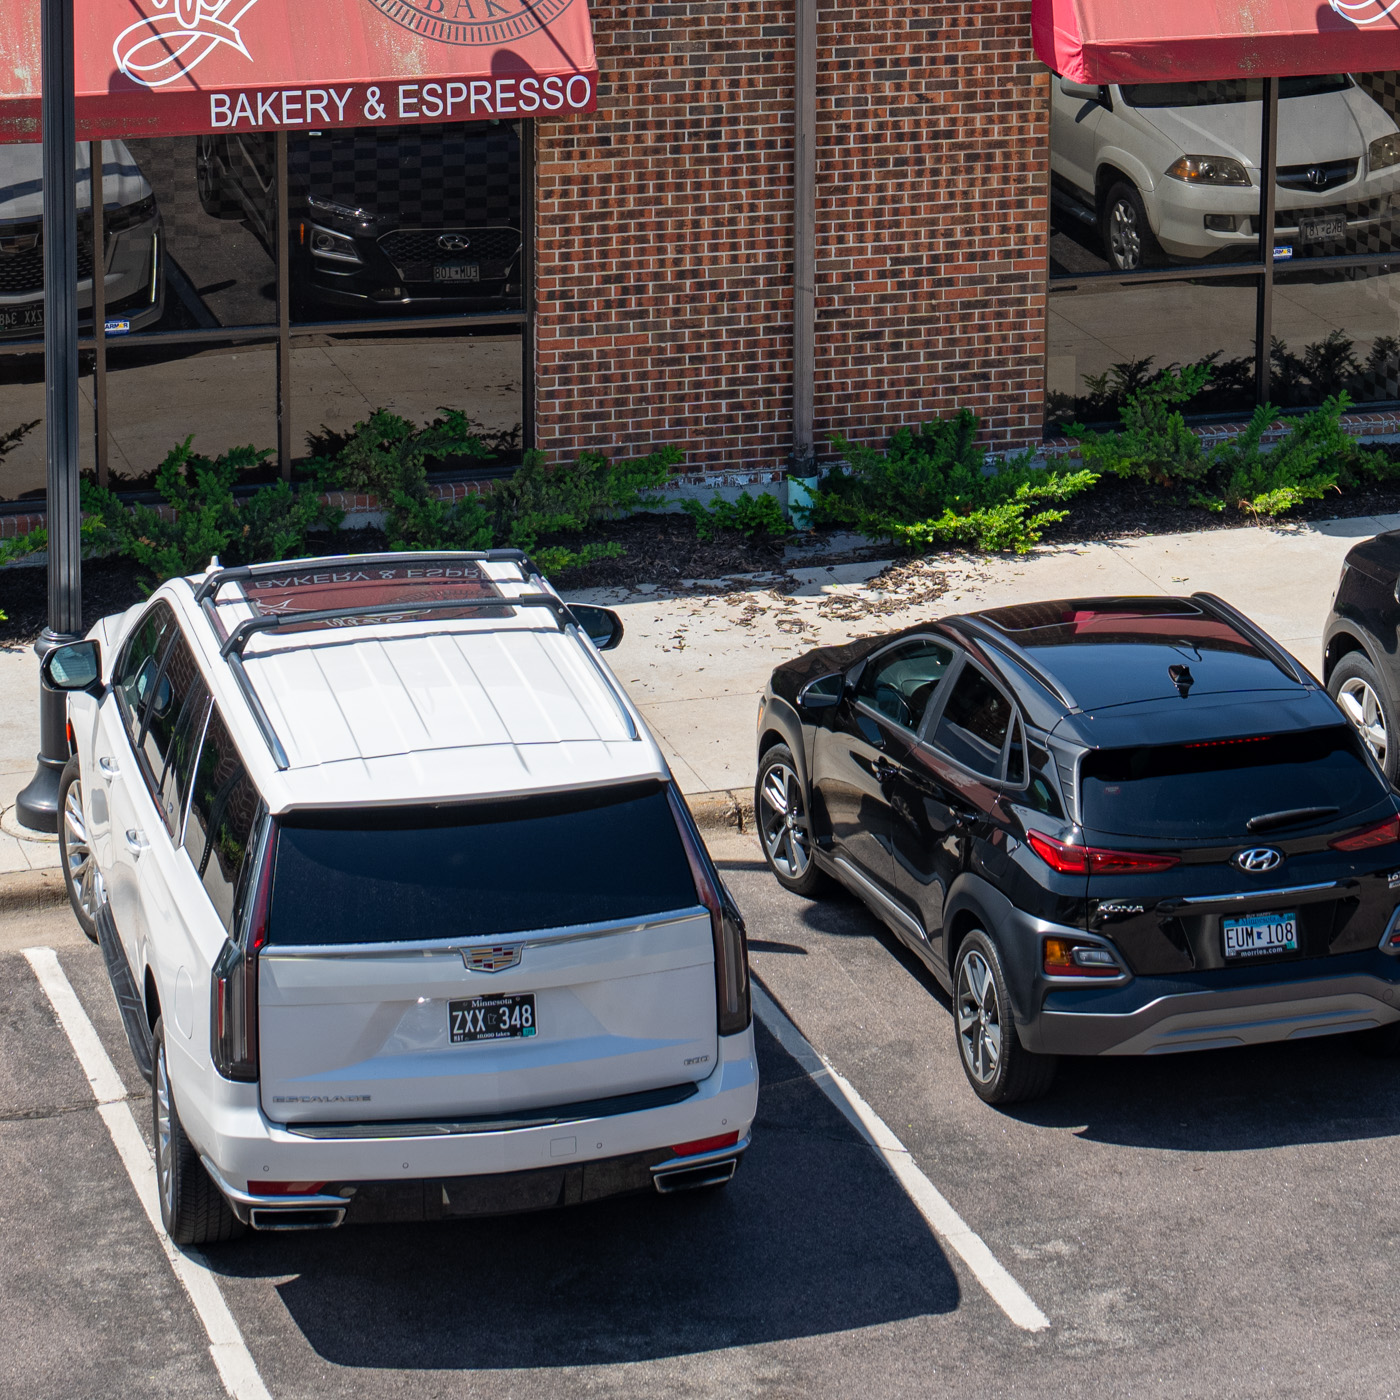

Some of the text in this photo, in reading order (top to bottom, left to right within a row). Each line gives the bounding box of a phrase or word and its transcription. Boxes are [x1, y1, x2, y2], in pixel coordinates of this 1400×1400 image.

[209, 75, 591, 128] BAKERY & ESPRESSO
[1097, 904, 1144, 912] KONA
[1226, 922, 1293, 948] EUM 108
[471, 998, 512, 1008] Minnesota
[452, 1004, 532, 1034] ZXX 348
[272, 1094, 371, 1103] ESCALADE
